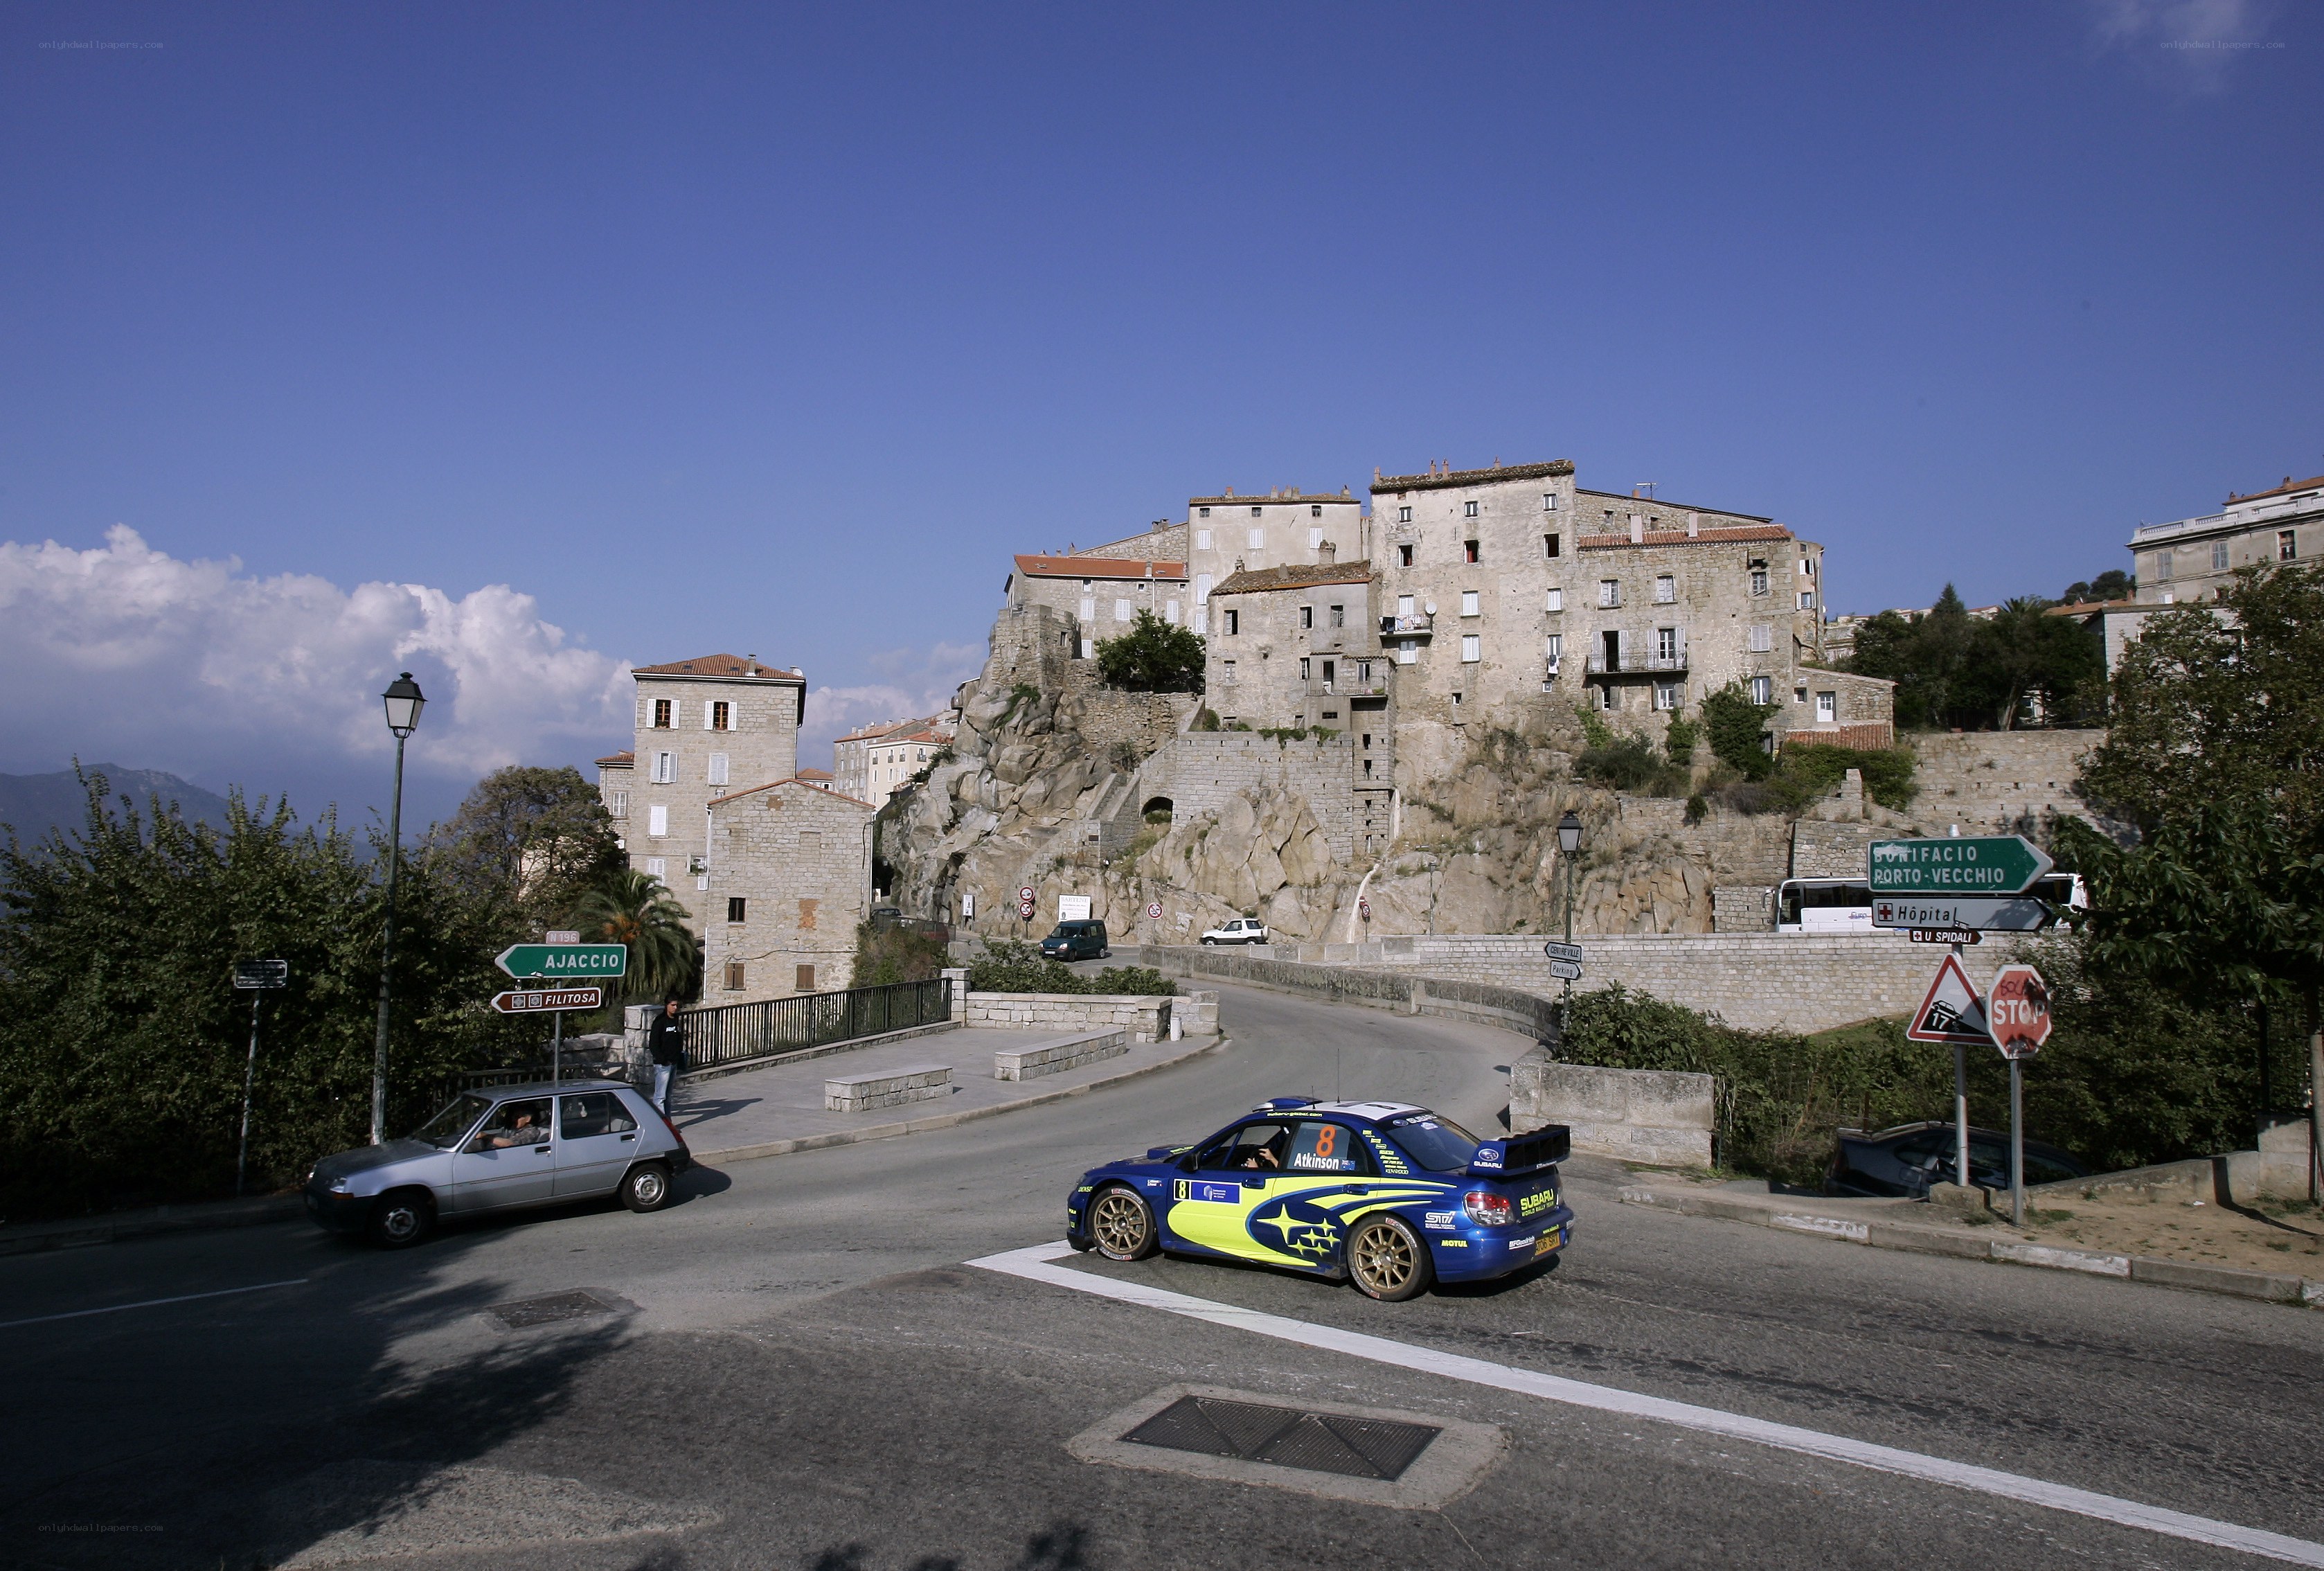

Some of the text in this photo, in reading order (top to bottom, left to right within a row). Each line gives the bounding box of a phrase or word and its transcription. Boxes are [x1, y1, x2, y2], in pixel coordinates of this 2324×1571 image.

[1897, 905, 1958, 924] Hôpital
[560, 933, 577, 942] 196
[1925, 931, 1972, 943] U SPIDALI
[545, 954, 620, 969] AJACCIO
[1553, 965, 1573, 977] Parking
[545, 993, 596, 1005] FILITOSA
[1994, 999, 2046, 1025] STOP
[1316, 1124, 1337, 1157] 8
[1294, 1152, 1339, 1170] Atkinson
[1474, 1160, 1502, 1169] SUBARU
[1179, 1180, 1186, 1199] 8
[1520, 1188, 1554, 1211] SUBARU
[1440, 1239, 1468, 1248] MOTUL
